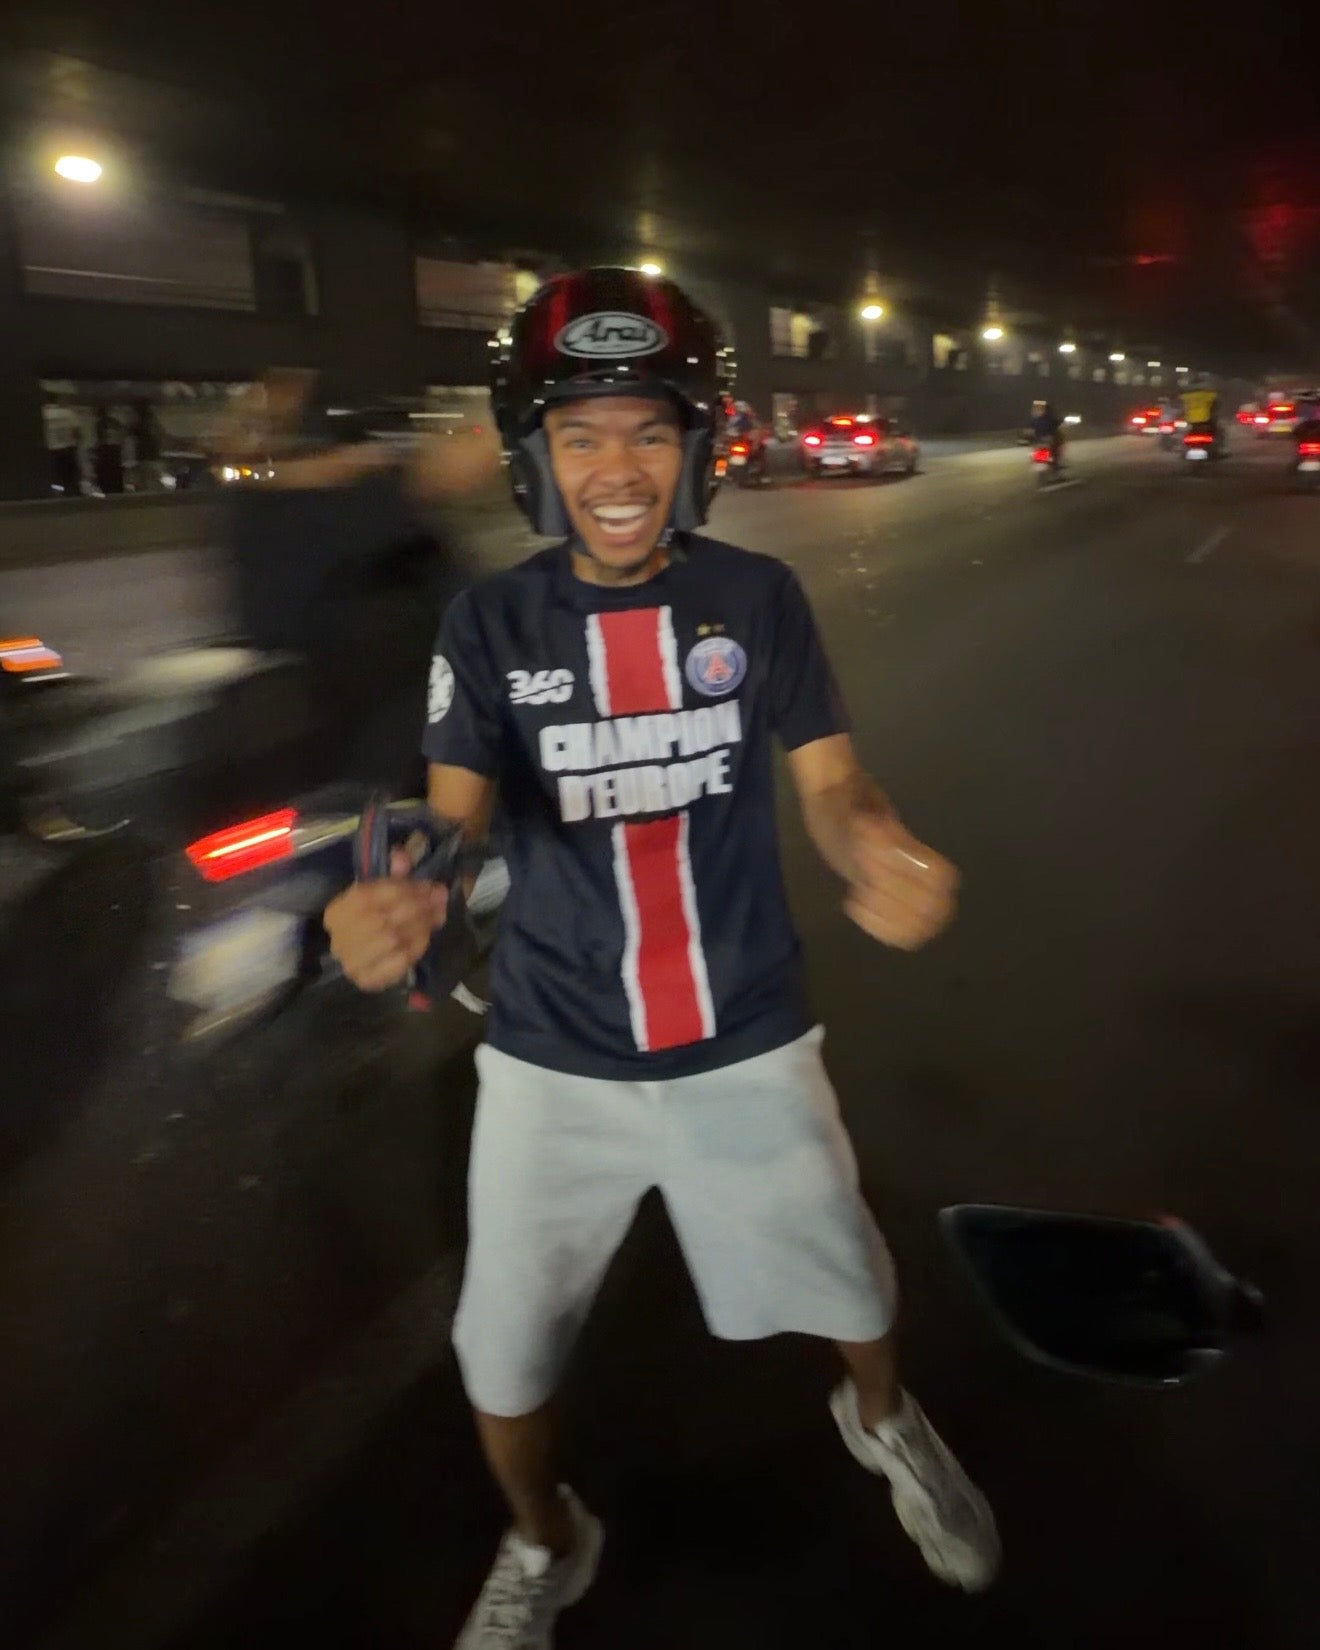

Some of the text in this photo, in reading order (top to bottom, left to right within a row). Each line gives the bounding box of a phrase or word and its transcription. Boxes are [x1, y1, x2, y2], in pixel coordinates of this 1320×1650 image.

[562, 319, 649, 347] Arai
[506, 669, 576, 705] 360
[538, 700, 742, 771] CHAMPION
[557, 749, 733, 822] D'EUROPE
